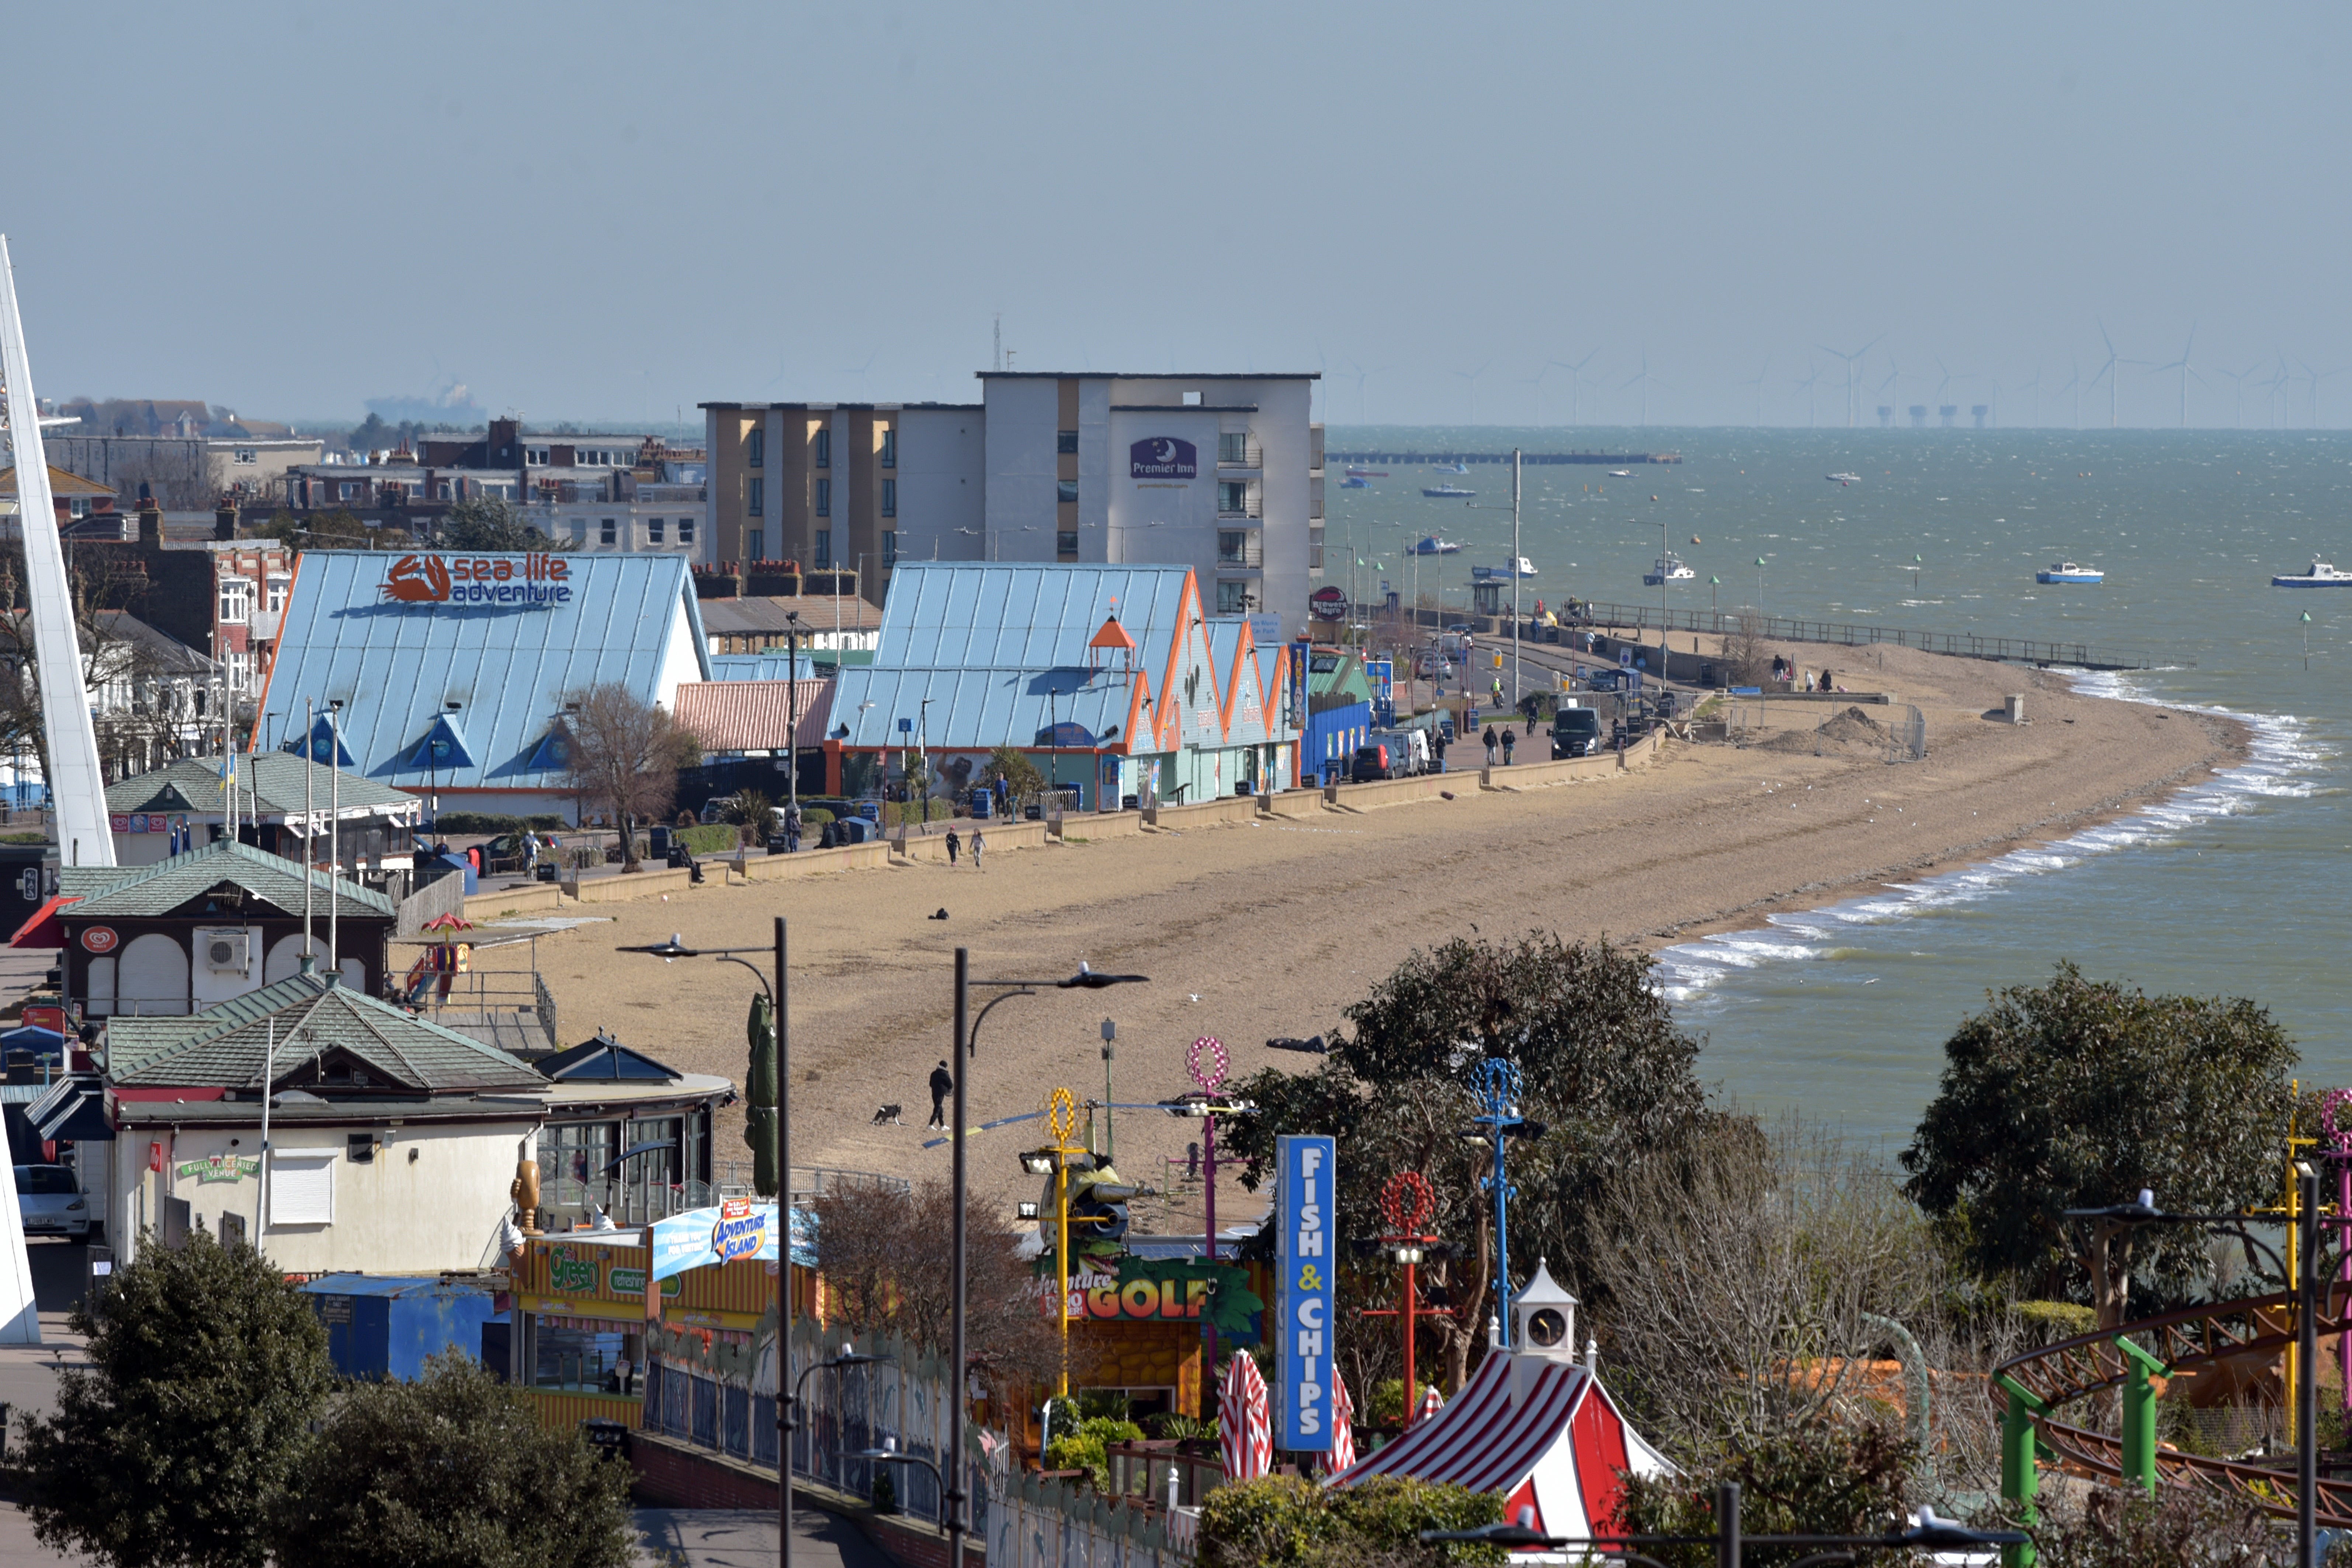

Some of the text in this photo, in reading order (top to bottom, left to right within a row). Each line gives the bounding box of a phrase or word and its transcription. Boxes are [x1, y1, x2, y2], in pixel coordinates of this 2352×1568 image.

[1134, 462, 1194, 473] Premier Inn
[454, 553, 569, 581] sea life
[453, 582, 570, 602] adventure
[1294, 648, 1303, 723] TAKEAWAY
[188, 1159, 257, 1172] FULLY LICENSED
[208, 1169, 236, 1177] VENUE
[1298, 1148, 1323, 1257] FISH
[670, 1231, 701, 1244] THANK YOU
[712, 1212, 766, 1250] ADVENTURE
[565, 1247, 576, 1260] the
[668, 1245, 679, 1255] FOR
[722, 1235, 757, 1265] ISLAND
[615, 1273, 645, 1291] refreshing
[1298, 1264, 1322, 1290] &
[1045, 1293, 1082, 1309] DO
[1087, 1279, 1206, 1318] GOLF
[1298, 1298, 1323, 1435] CHIPS
